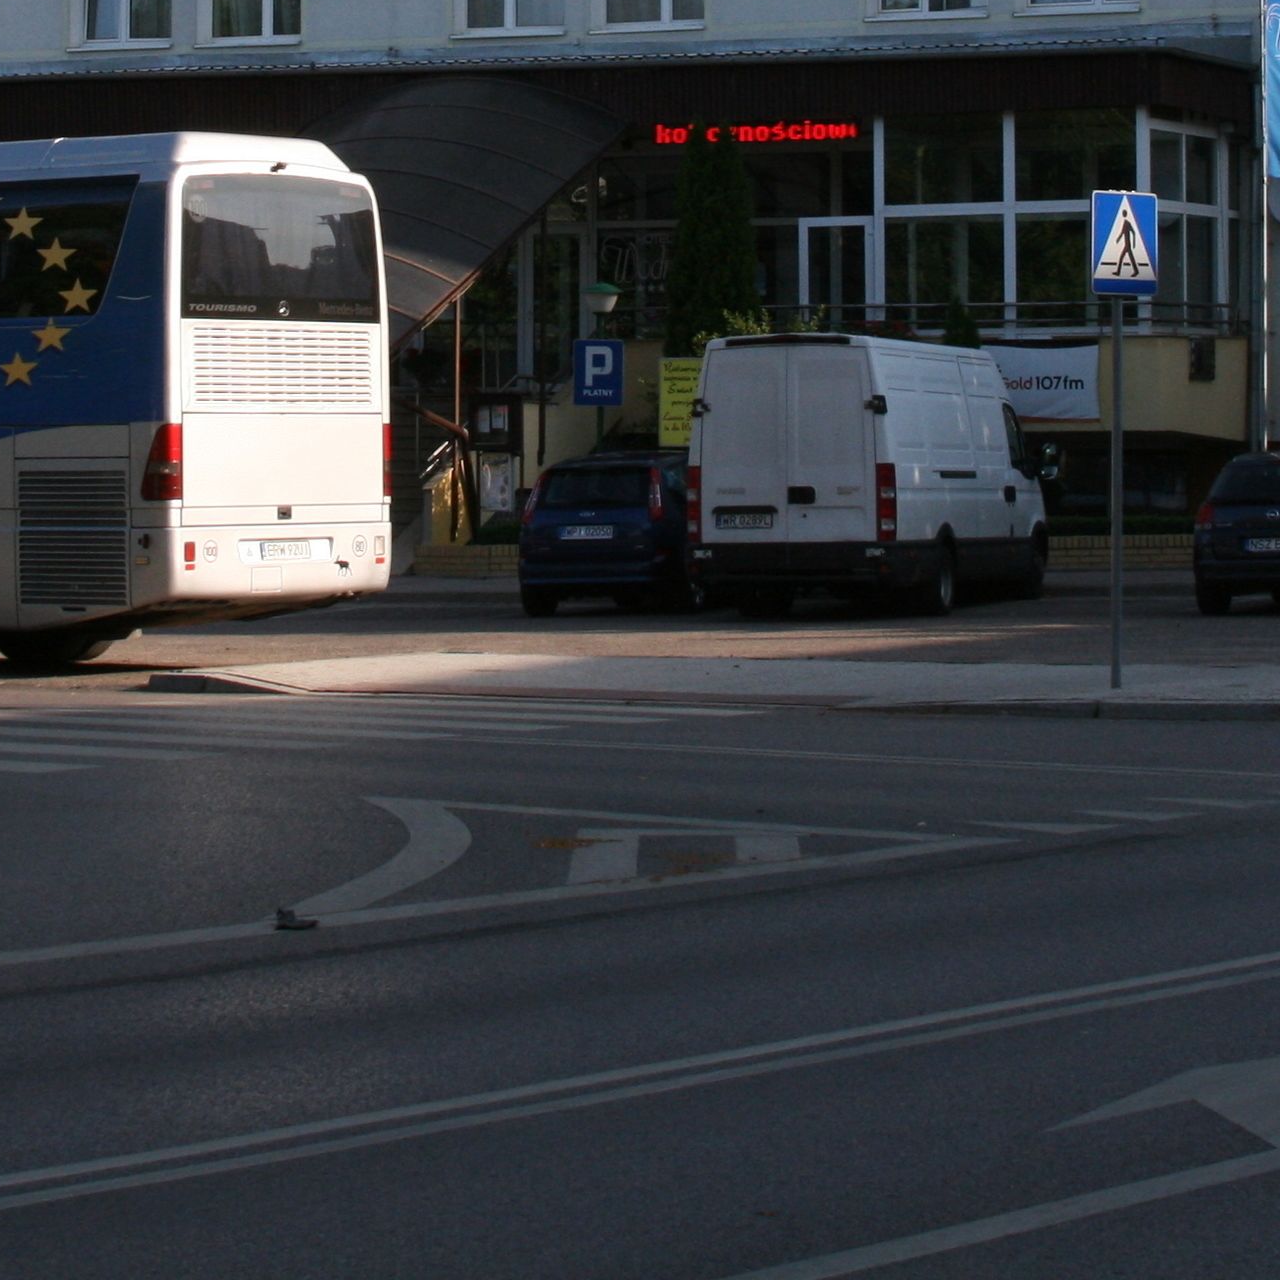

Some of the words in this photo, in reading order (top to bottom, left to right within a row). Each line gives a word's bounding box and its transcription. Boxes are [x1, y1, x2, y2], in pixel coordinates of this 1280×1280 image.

[188, 302, 257, 313] TOURISMO
[585, 345, 614, 387] P
[1250, 538, 1271, 550] NSZ
[205, 545, 218, 557] 100
